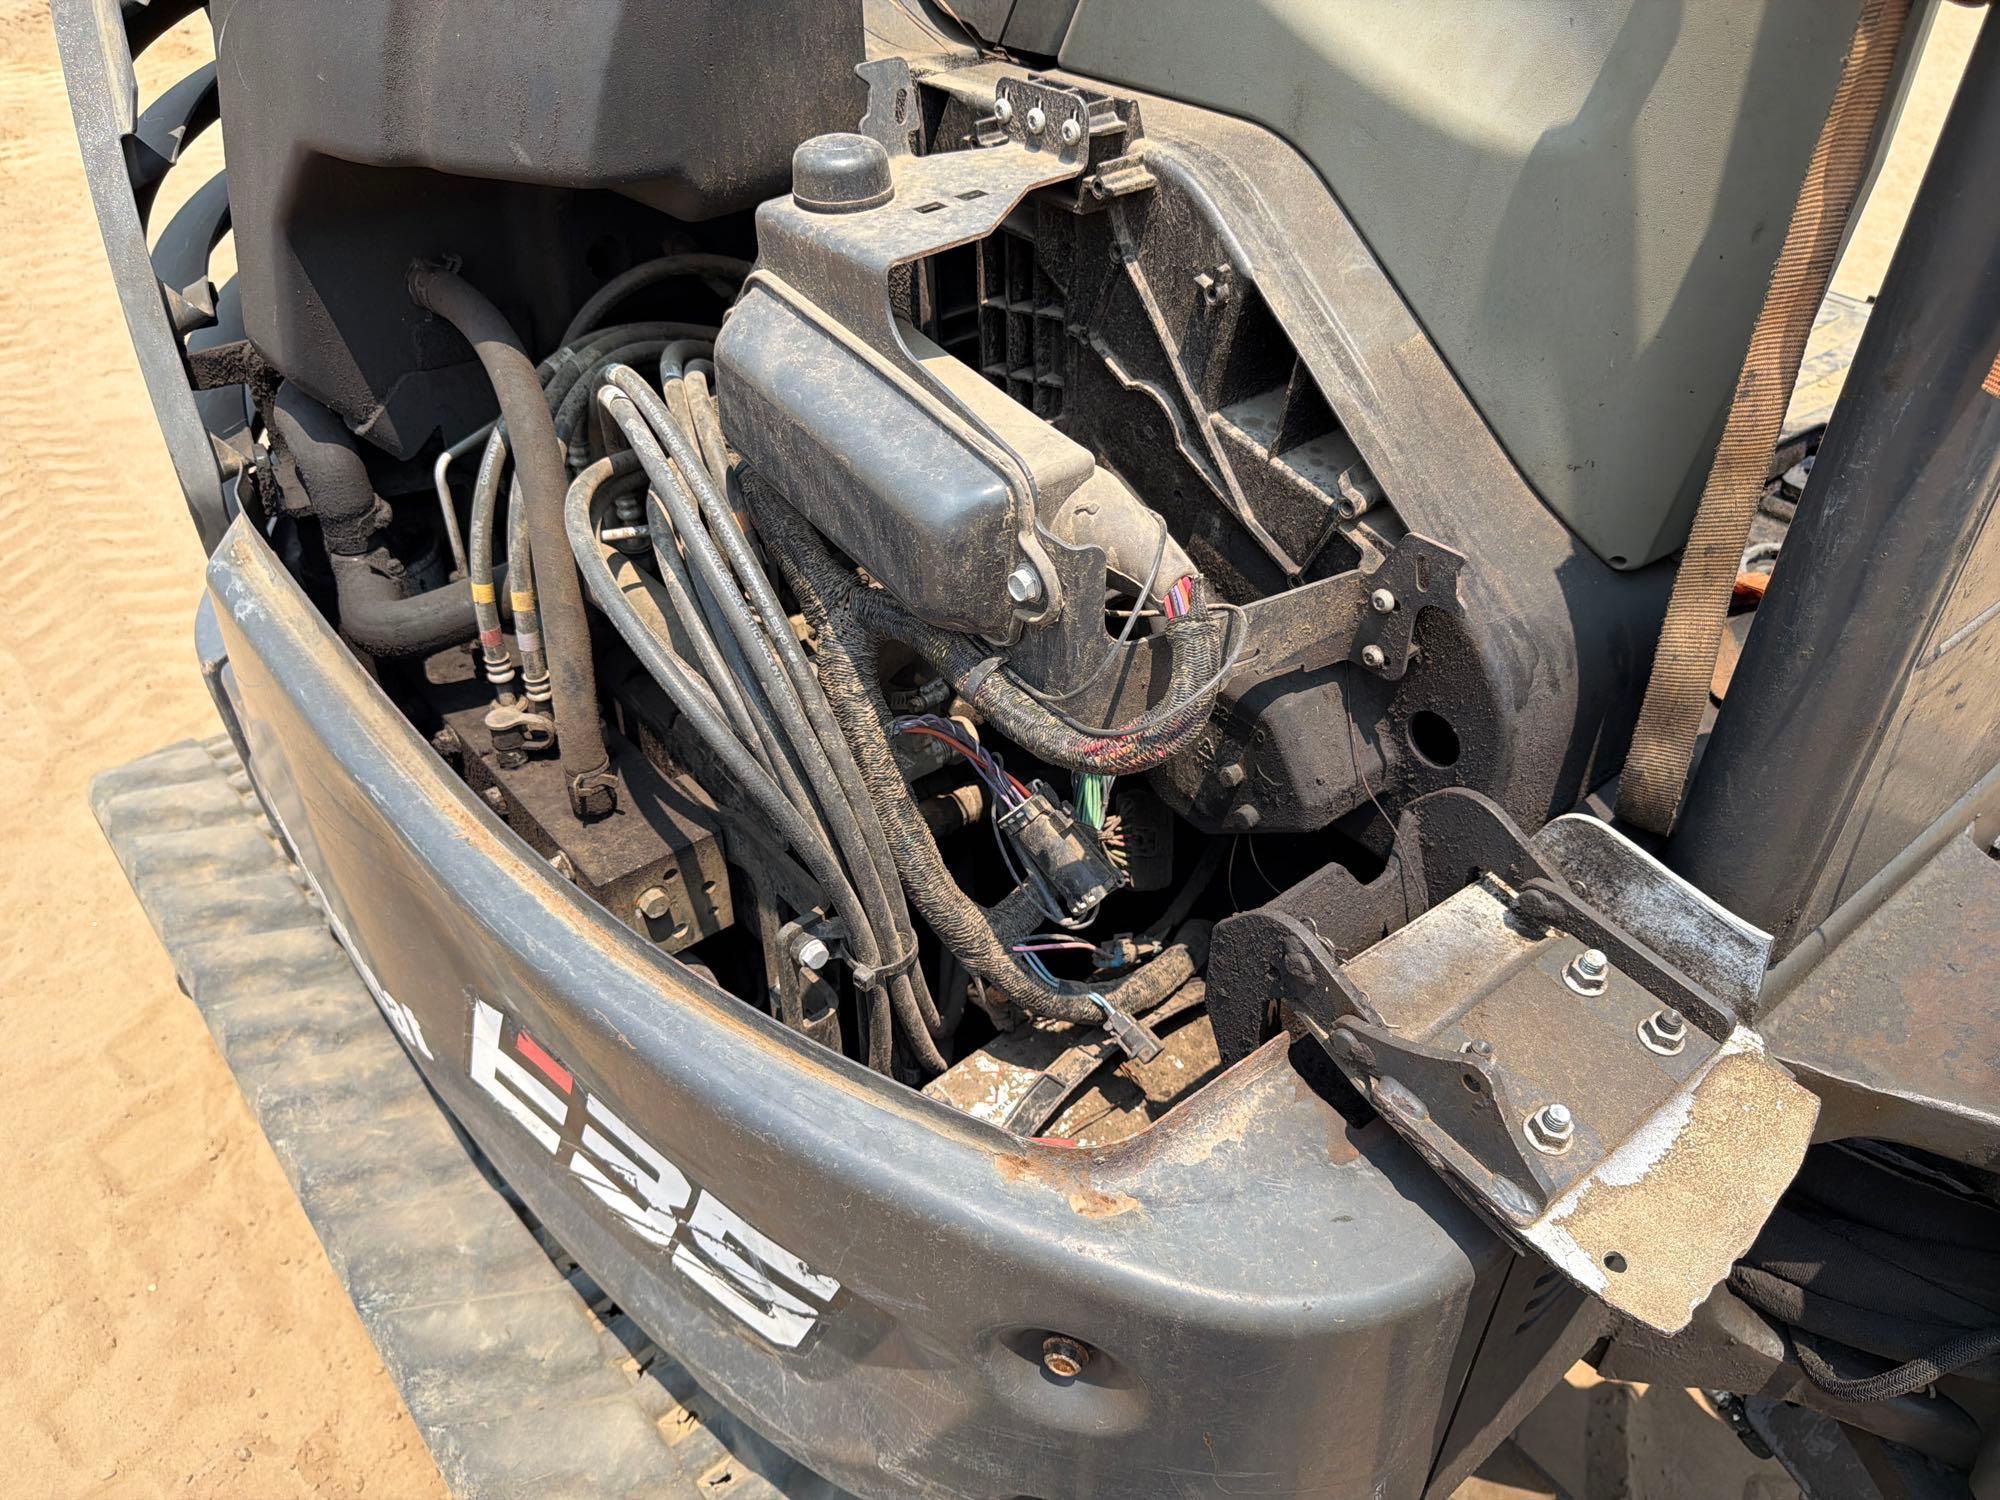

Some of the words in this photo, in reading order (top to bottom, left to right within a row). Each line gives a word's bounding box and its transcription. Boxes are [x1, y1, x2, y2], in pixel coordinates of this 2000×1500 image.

[480, 452, 494, 485] MEXICO
[768, 615, 789, 645] GATES
[755, 637, 776, 665] MADE
[775, 675, 799, 710] MEXICO
[470, 998, 840, 1348] E35
